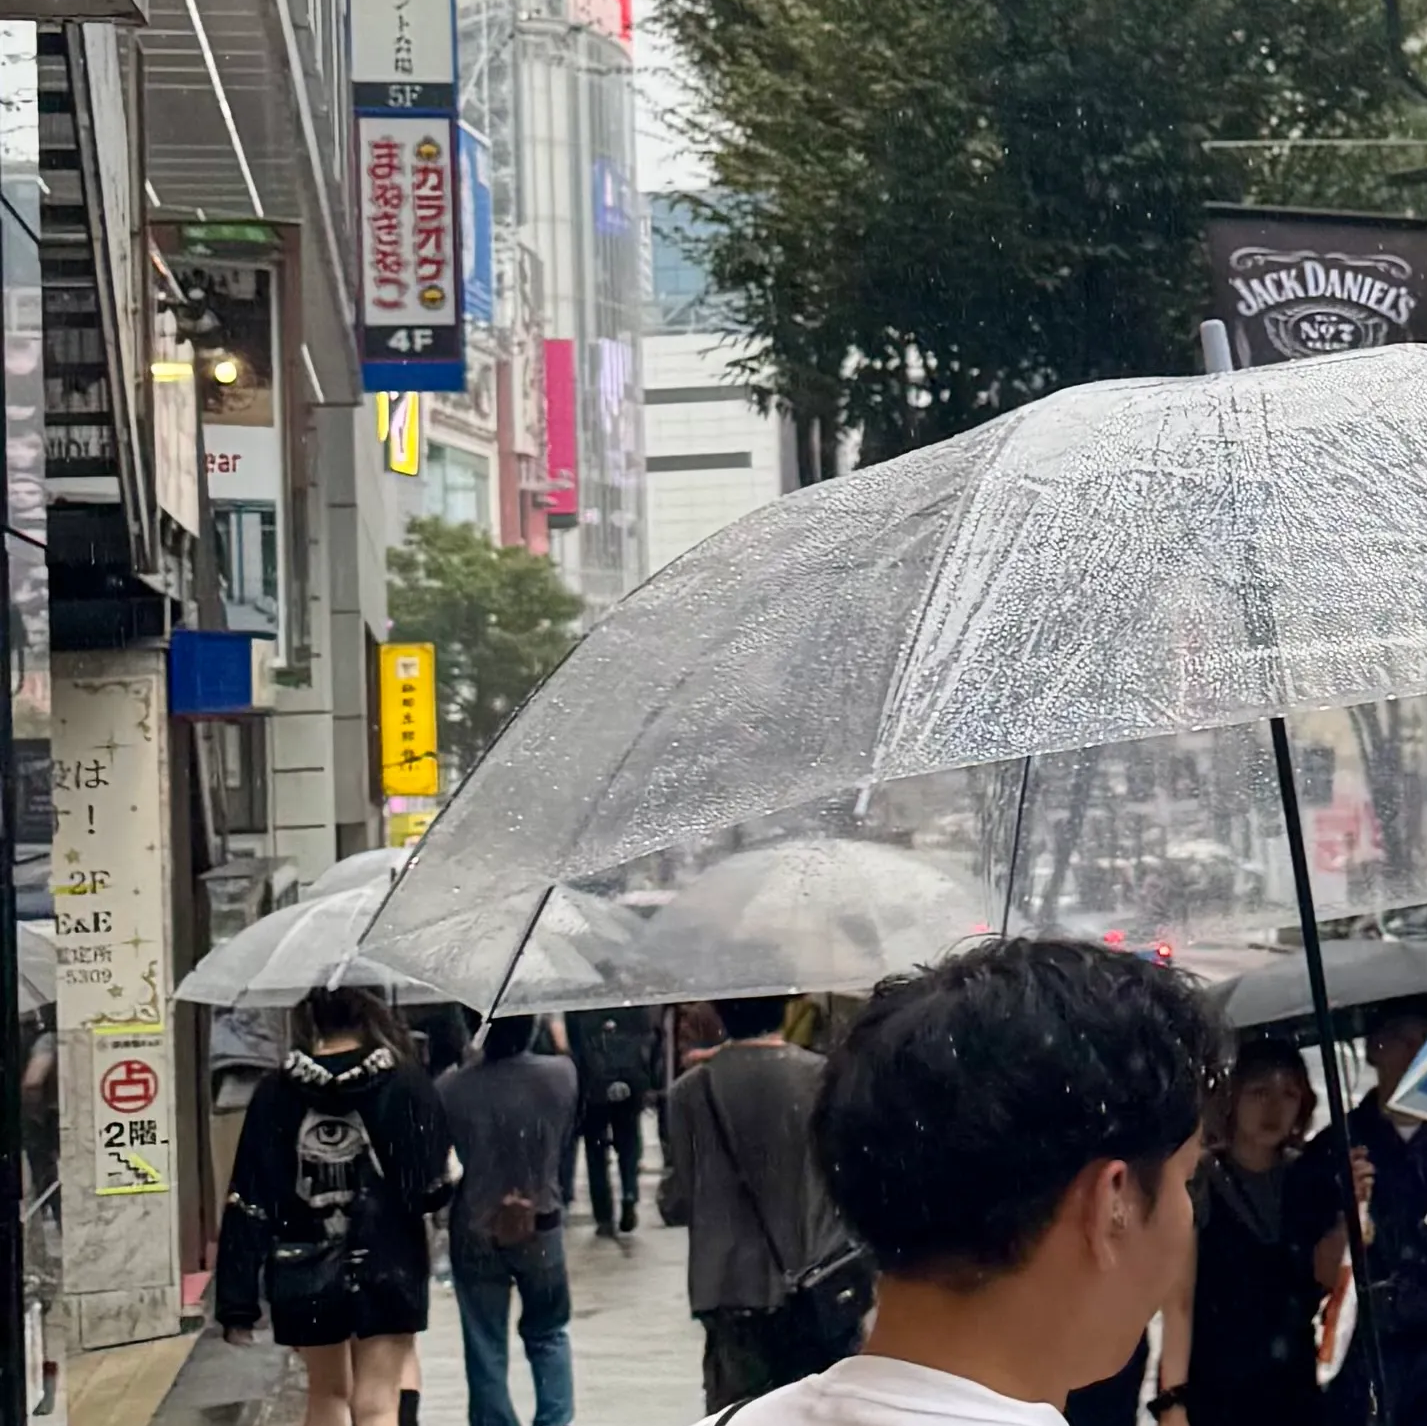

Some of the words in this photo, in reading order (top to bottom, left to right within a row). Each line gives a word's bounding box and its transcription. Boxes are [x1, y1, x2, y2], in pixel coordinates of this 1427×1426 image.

[387, 84, 422, 108] 5F
[412, 164, 446, 282] カラオケ
[1230, 267, 1304, 317] JACK
[1303, 259, 1416, 326] DANIEL'S
[387, 329, 434, 354] 4F
[69, 870, 111, 896] 2F
[54, 911, 113, 935] E&E
[104, 1120, 157, 1149] 2階
